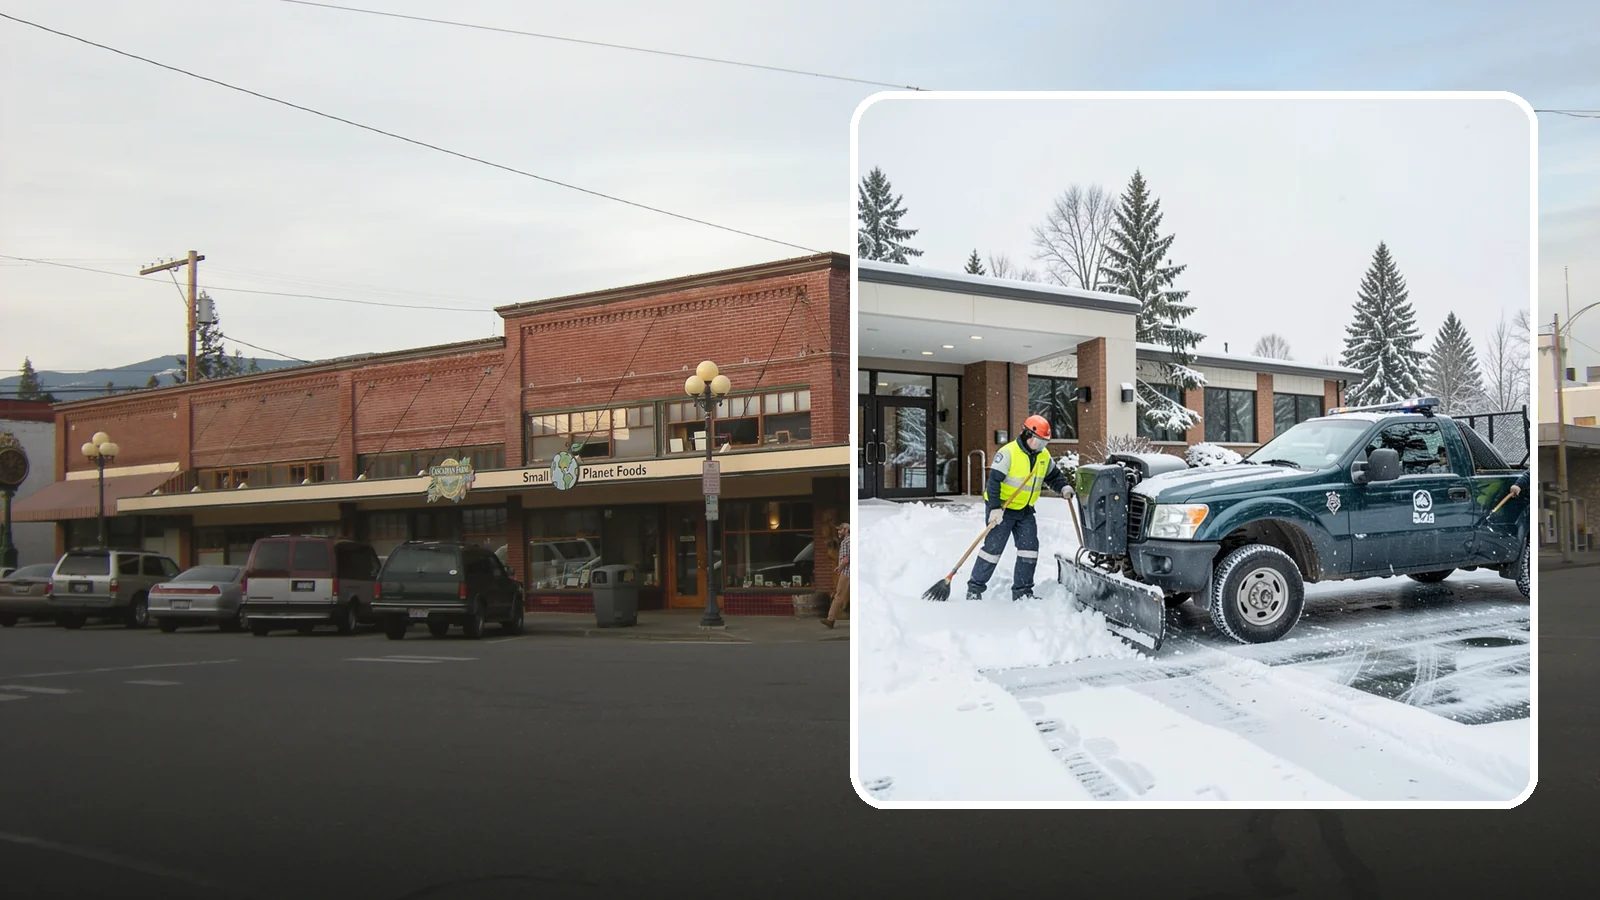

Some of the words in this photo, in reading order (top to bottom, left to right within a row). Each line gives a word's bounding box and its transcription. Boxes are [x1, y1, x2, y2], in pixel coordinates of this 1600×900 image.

[523, 470, 549, 483] Small
[583, 467, 614, 479] Planet
[617, 464, 647, 477] Foods
